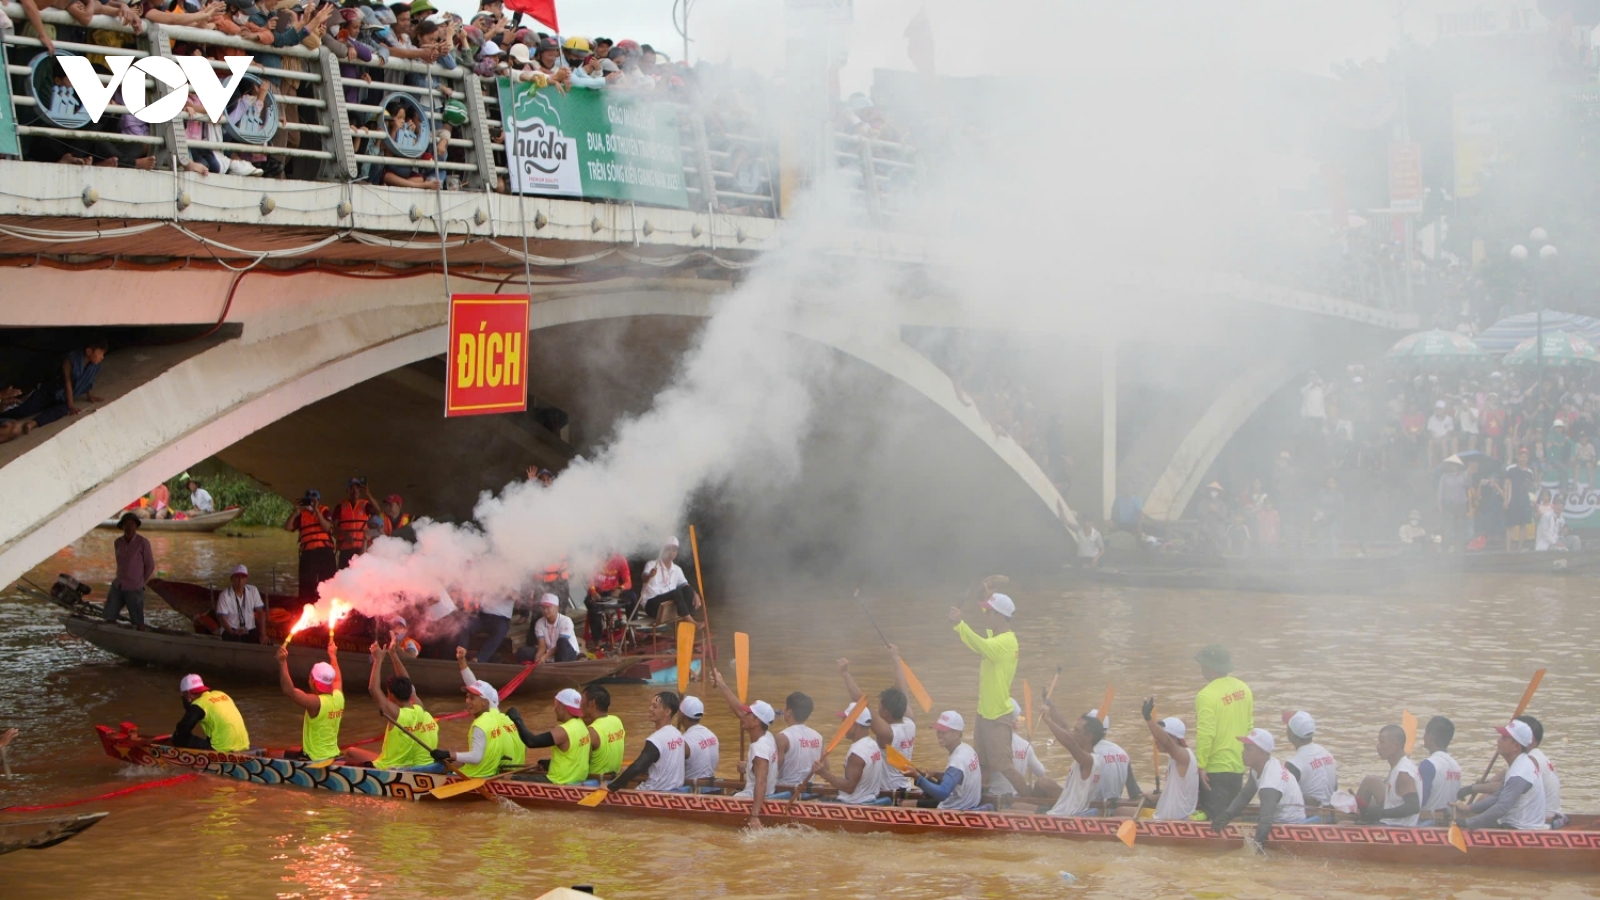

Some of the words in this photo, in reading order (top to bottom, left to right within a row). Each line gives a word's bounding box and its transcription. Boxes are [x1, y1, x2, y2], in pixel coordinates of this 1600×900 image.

[587, 131, 606, 154] ĐUA,
[587, 158, 607, 181] TRÊN
[607, 159, 625, 183] SÔNG
[457, 321, 522, 388] ĐÍCH
